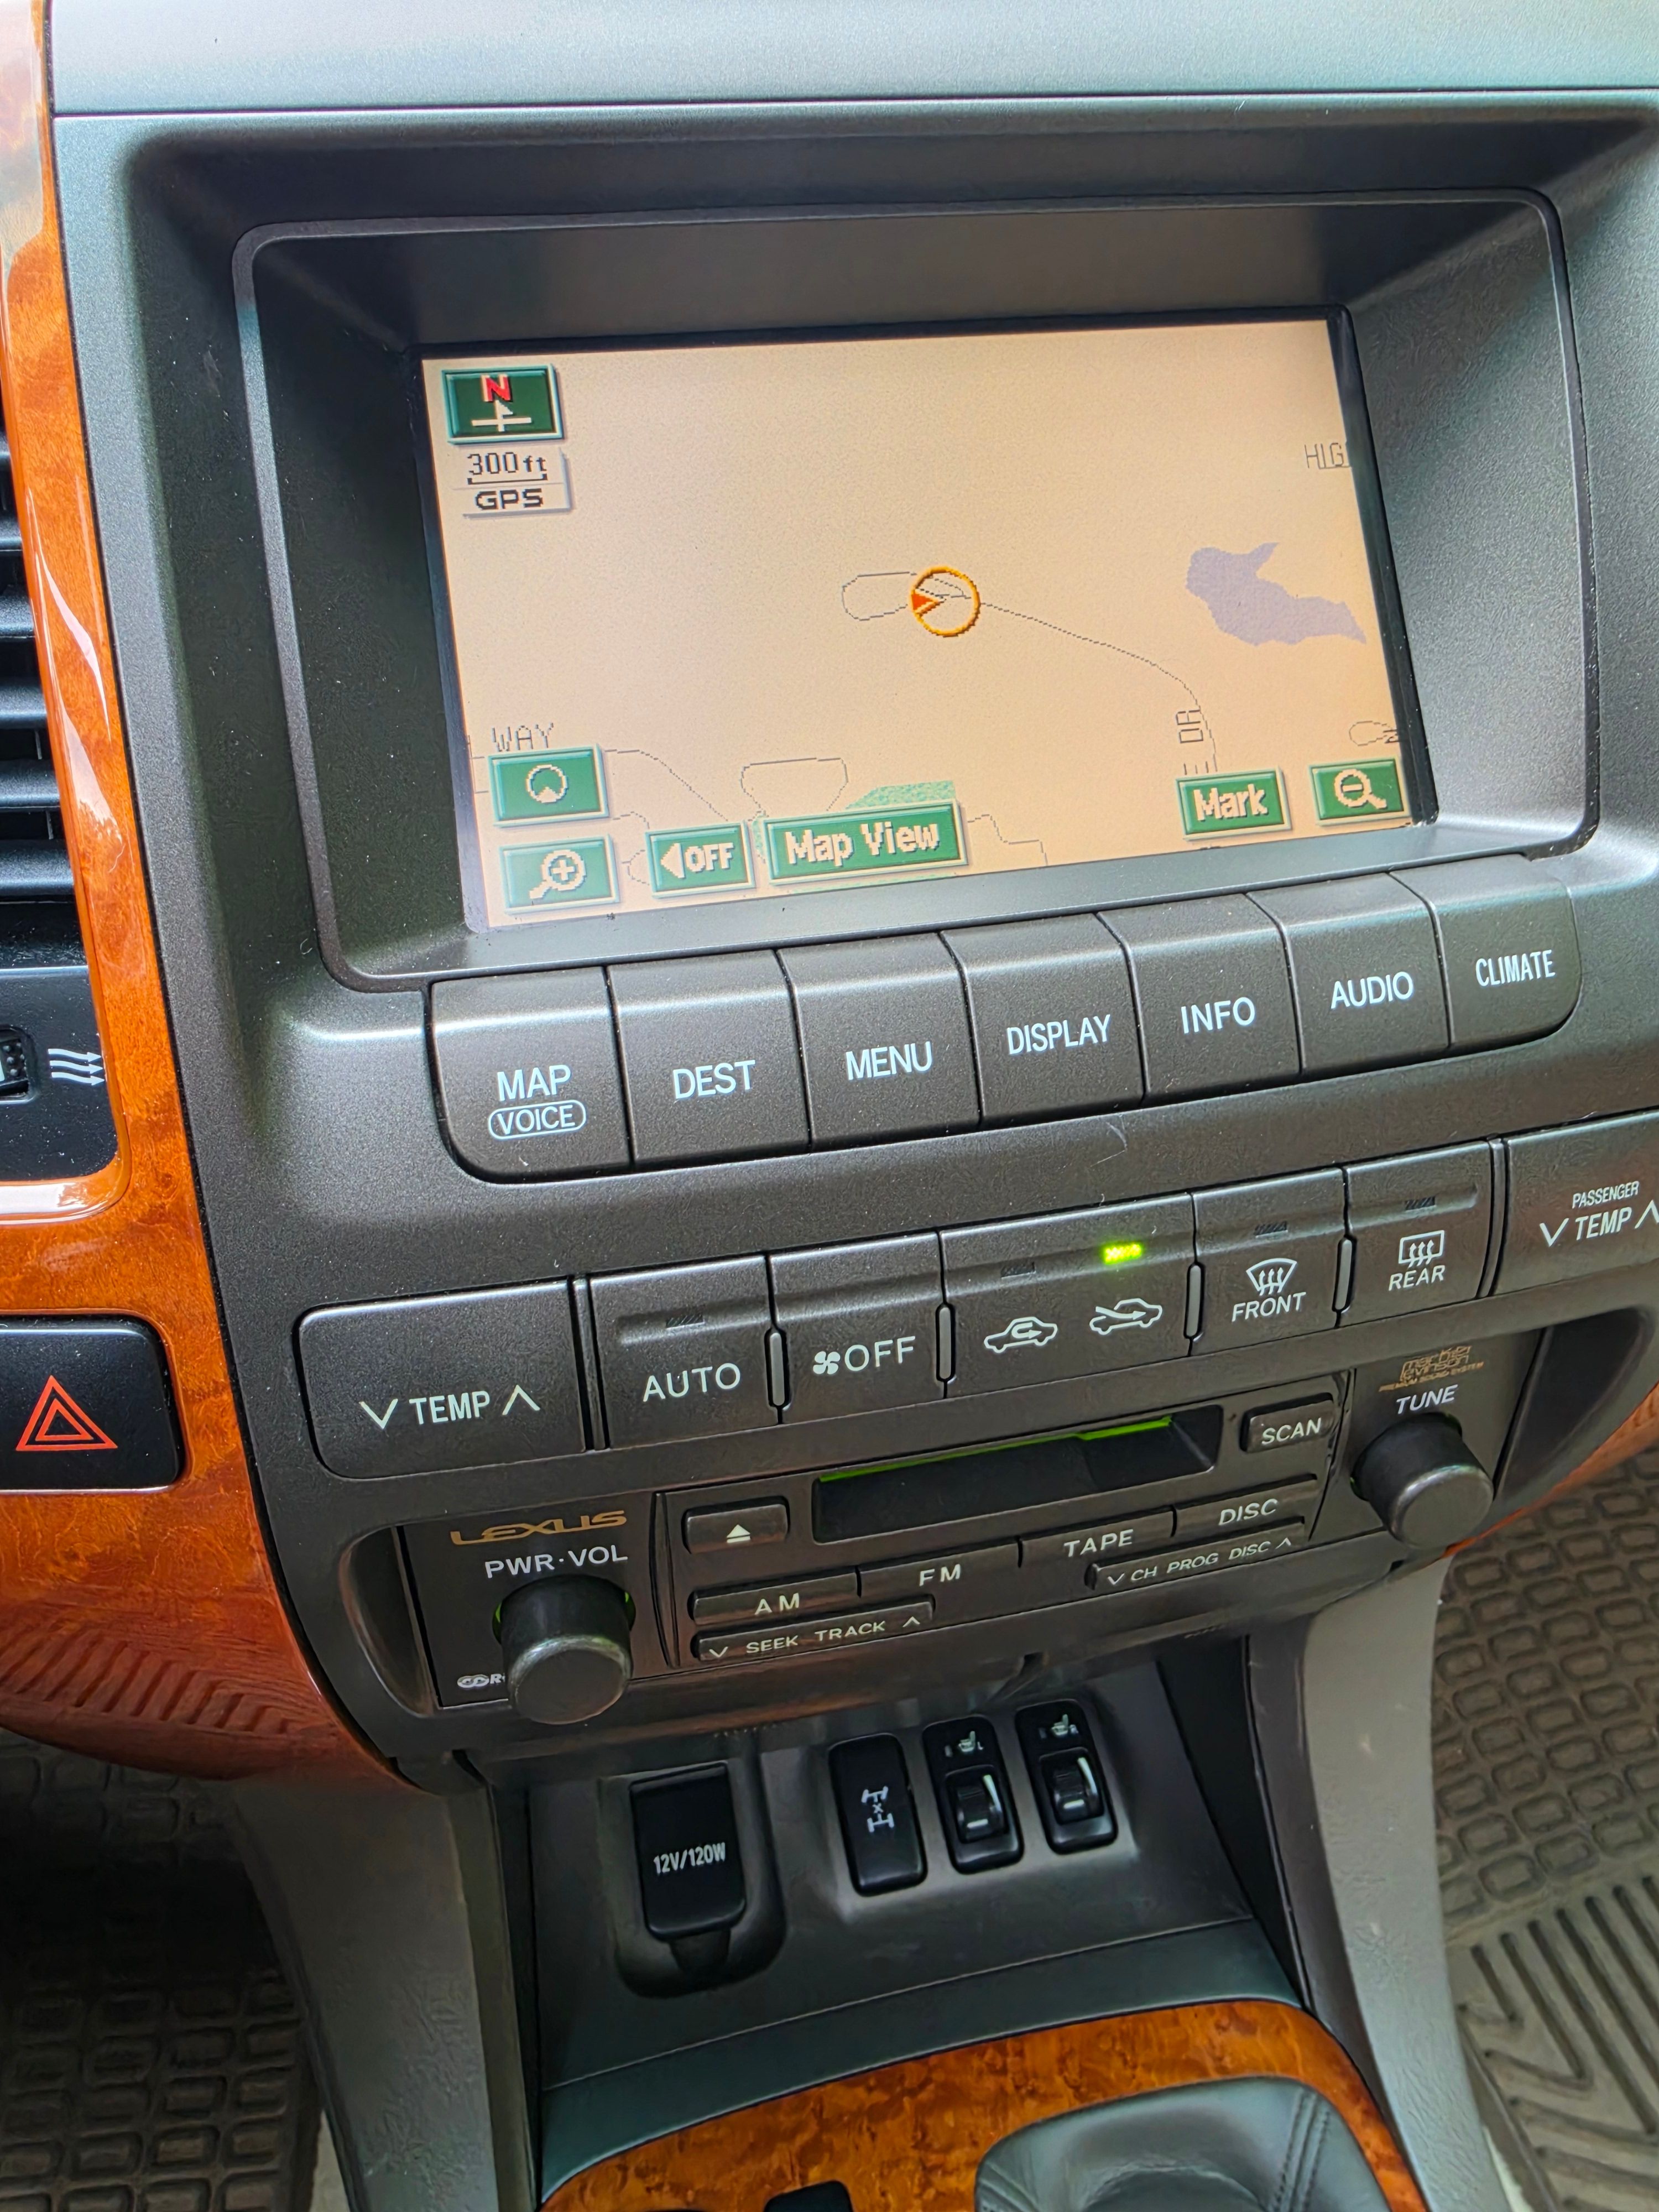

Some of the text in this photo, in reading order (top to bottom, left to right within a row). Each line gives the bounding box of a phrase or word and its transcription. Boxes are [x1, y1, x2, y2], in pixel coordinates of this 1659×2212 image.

[481, 374, 512, 402] N
[475, 488, 543, 510] GPS
[491, 722, 554, 752] WAY
[1193, 783, 1268, 821] Mark
[685, 842, 734, 873] OFF
[785, 821, 940, 867] Map View
[1475, 950, 1556, 987] CLIMATE
[1330, 971, 1415, 1009] AUDIO
[1181, 997, 1255, 1034] INFO
[1006, 1014, 1111, 1055] DISPLAY
[846, 1041, 933, 1081] MENU
[497, 1065, 571, 1101] MAP
[673, 1060, 755, 1099] DEST
[498, 1105, 576, 1135] VOICE
[1572, 1181, 1640, 1209] PASSENGER
[1575, 1207, 1632, 1241] TEMP
[1388, 1265, 1446, 1291] REAR
[1232, 1292, 1306, 1322] FRONT
[844, 1335, 916, 1372] OFF
[642, 1363, 741, 1402] AUTO
[1396, 1384, 1458, 1415] TUNE
[409, 1391, 491, 1425] TEMP
[1261, 1417, 1322, 1446] SCAN
[450, 1510, 628, 1546] LEXUS
[1218, 1498, 1279, 1526] DISC
[1063, 1529, 1134, 1558] TAPE
[919, 1563, 961, 1587] FM
[1130, 1541, 1271, 1582] CH PROG DISC
[754, 1593, 800, 1616] AM
[745, 1620, 886, 1654] SEEK TRACK
[653, 1841, 726, 1875] 12V/120W
